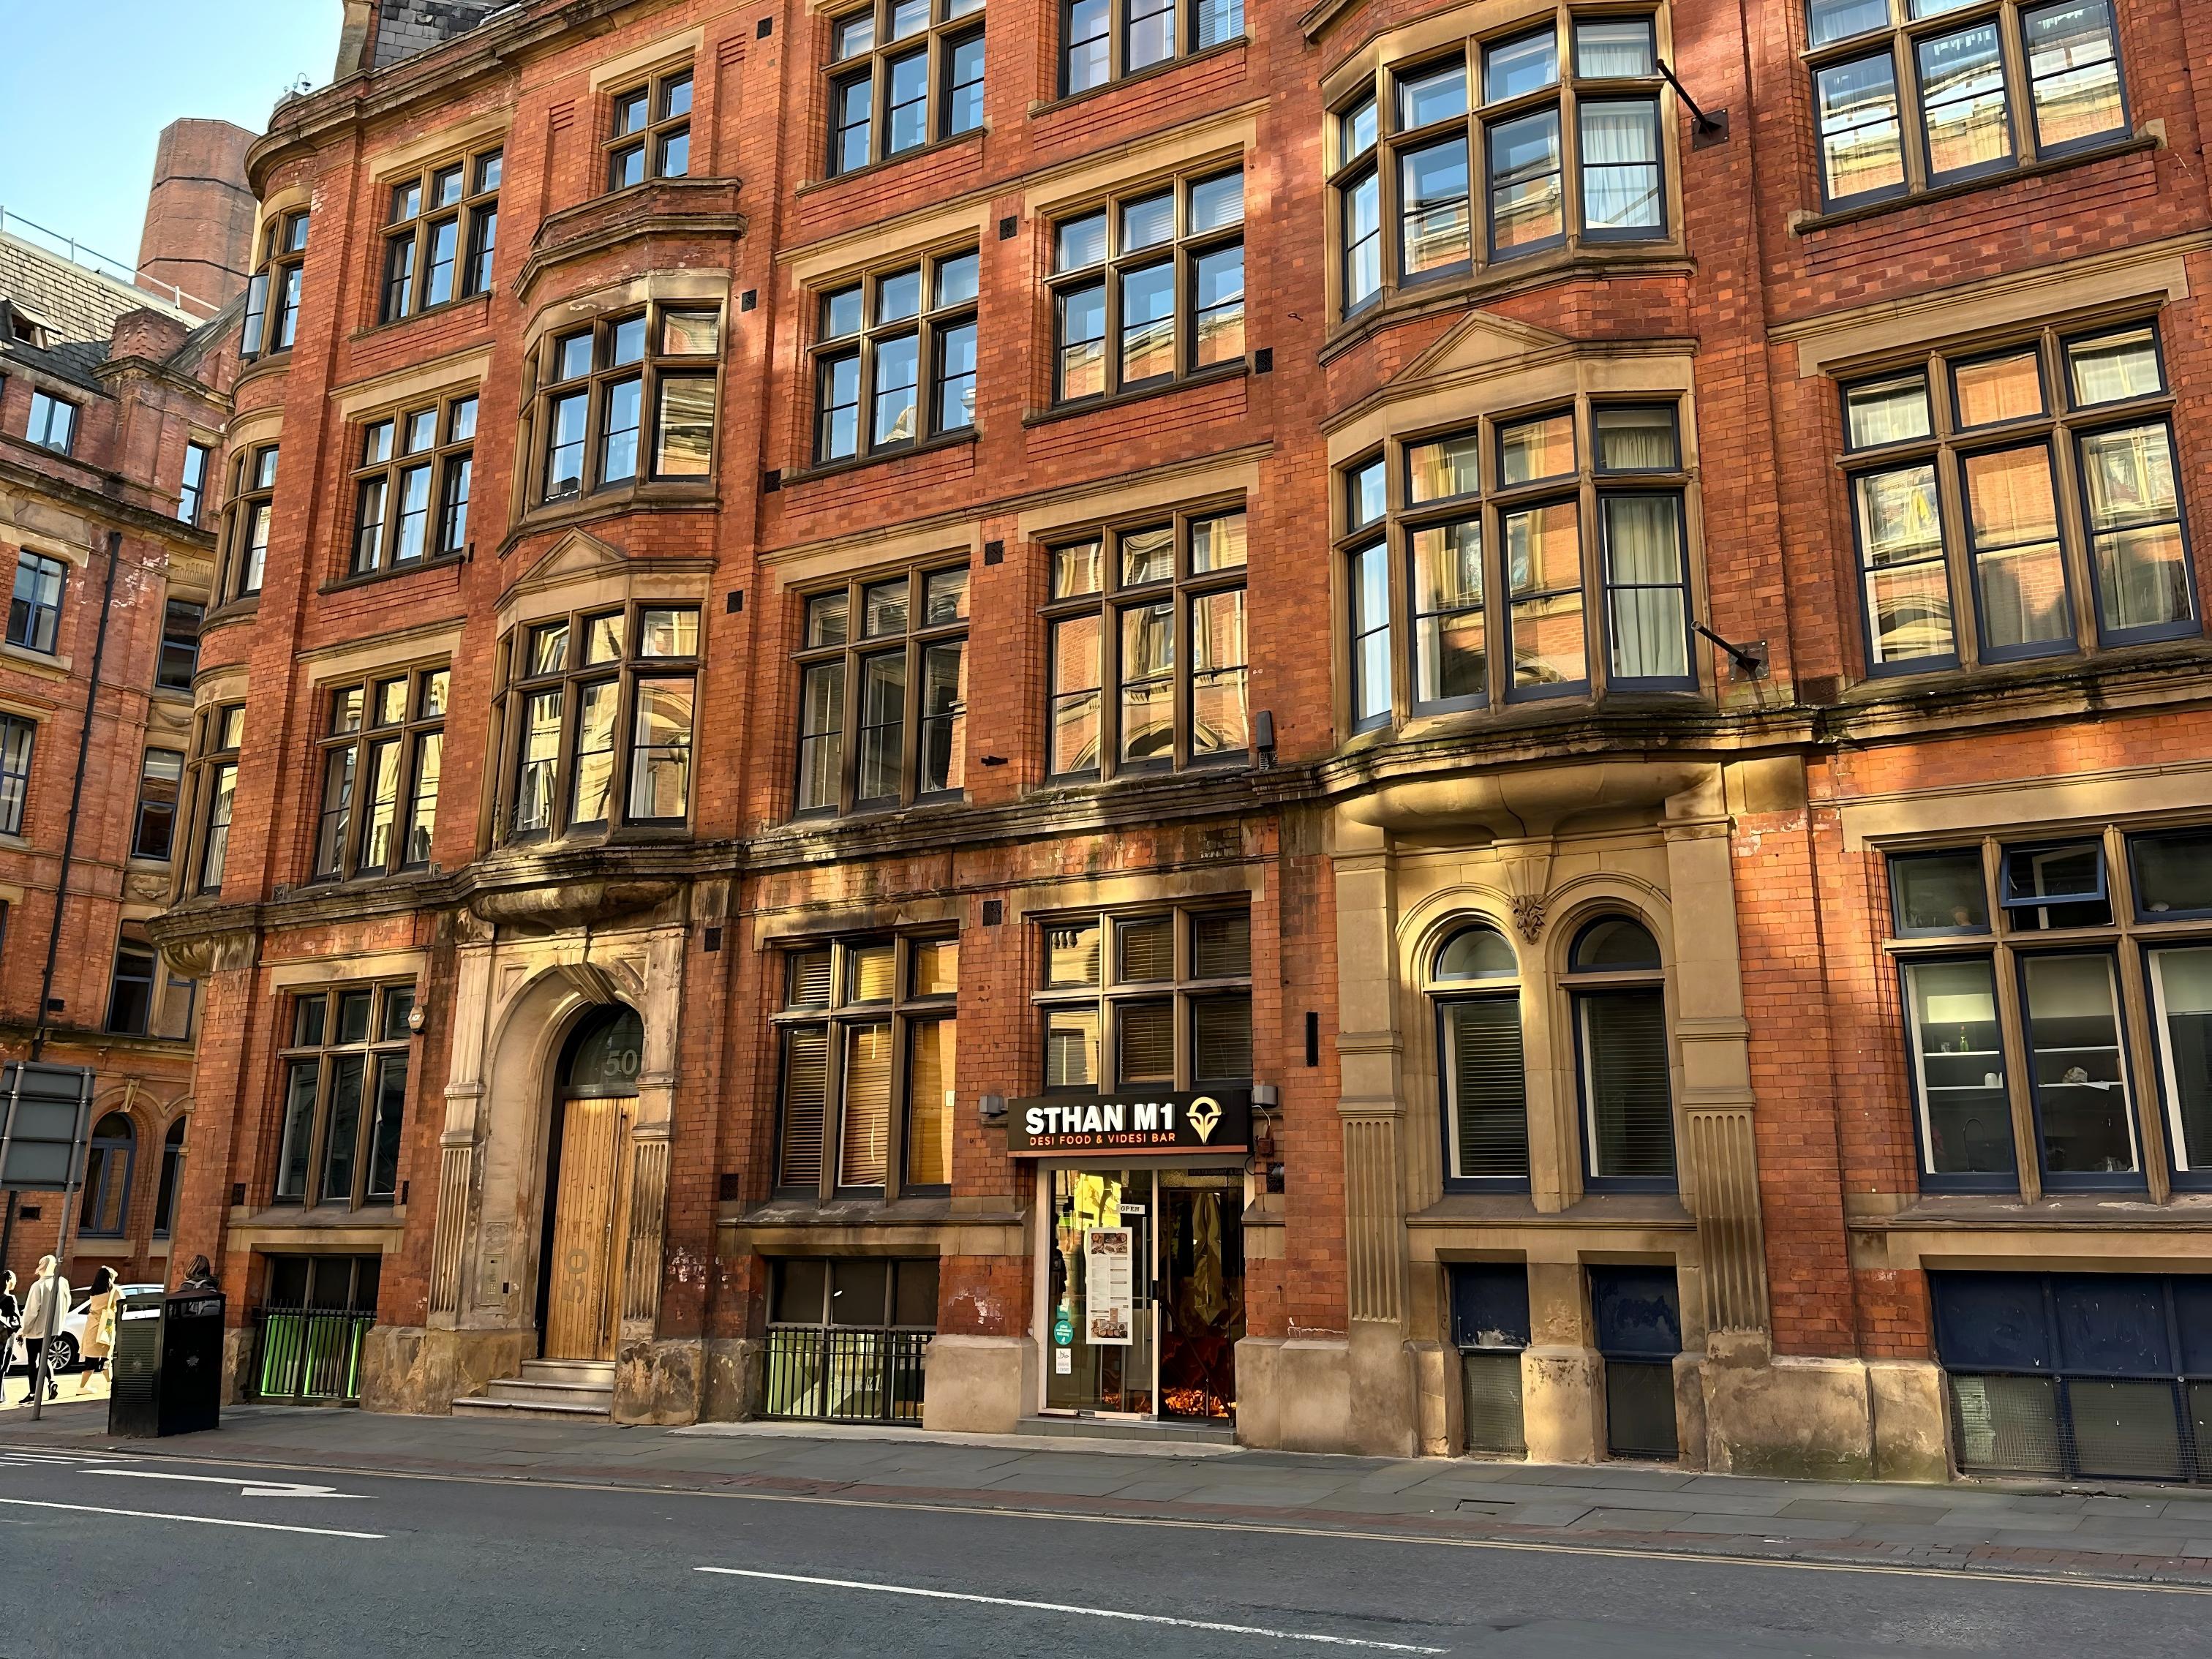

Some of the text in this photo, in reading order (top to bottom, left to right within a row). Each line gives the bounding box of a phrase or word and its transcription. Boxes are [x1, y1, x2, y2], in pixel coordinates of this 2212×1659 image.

[603, 1049, 637, 1076] 50
[1026, 1103, 1175, 1135] STHAN M1
[1029, 1132, 1175, 1146] DESI FOOD & VIDESI BAR
[562, 1248, 588, 1304] 50
